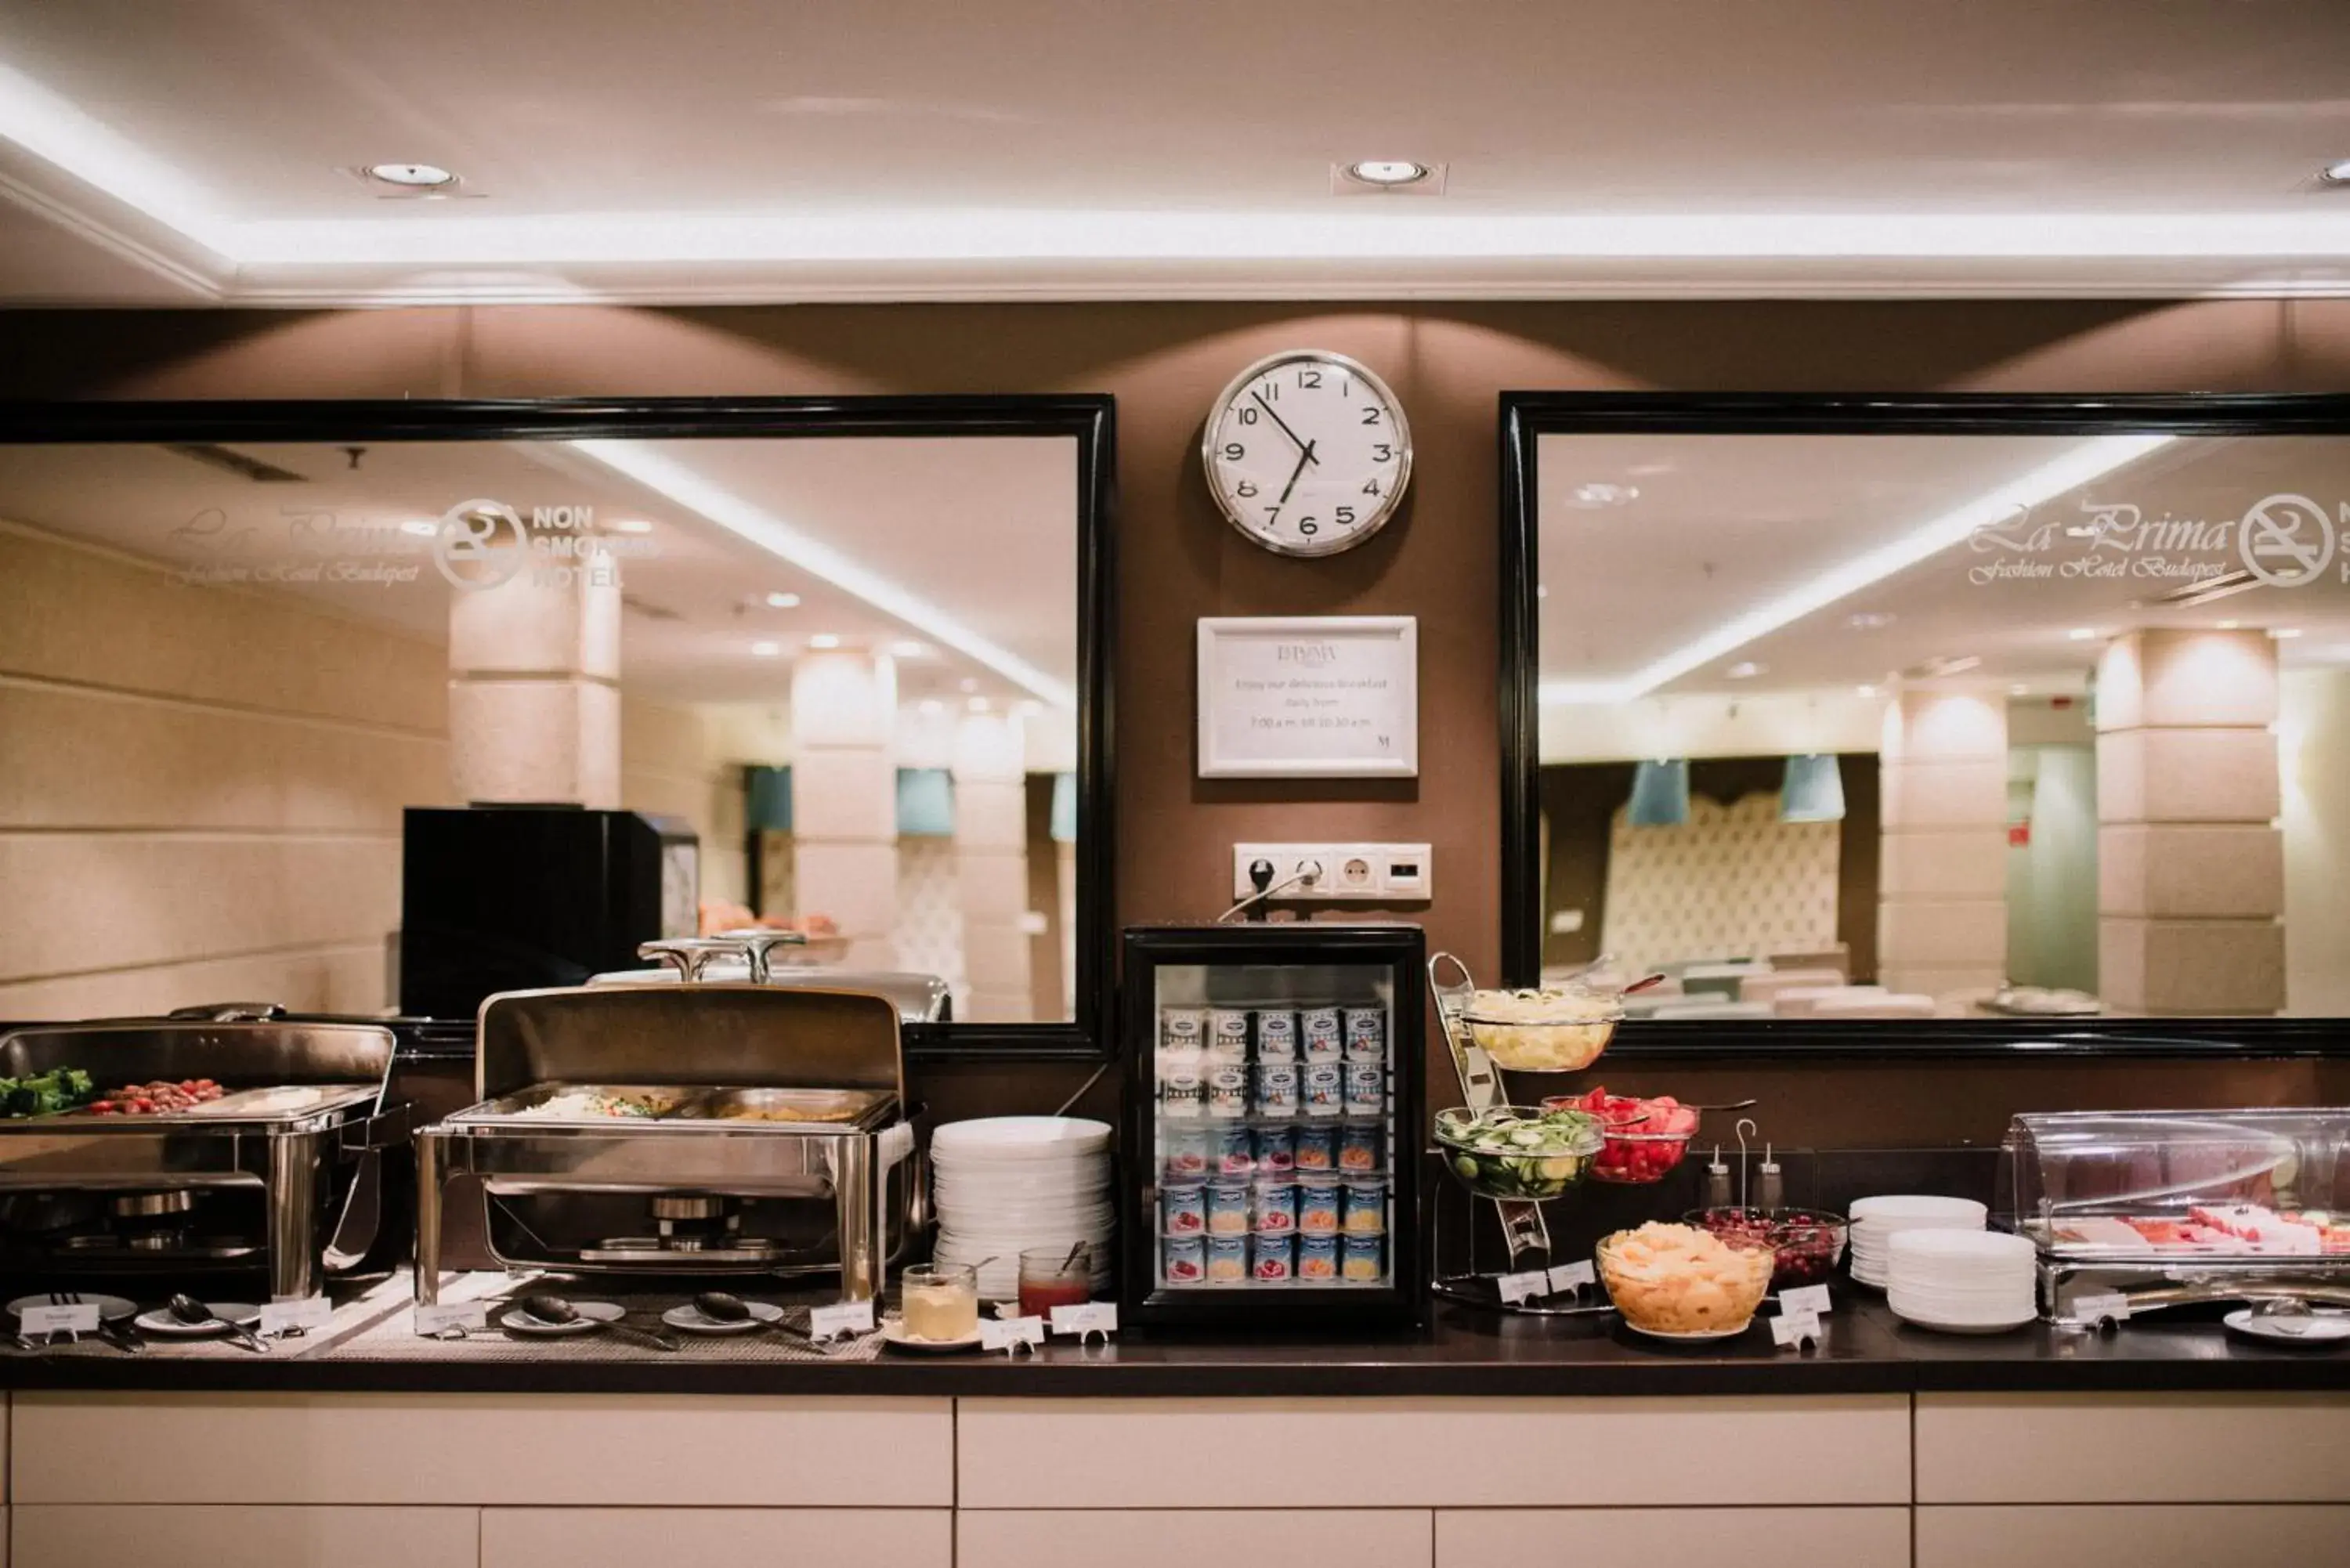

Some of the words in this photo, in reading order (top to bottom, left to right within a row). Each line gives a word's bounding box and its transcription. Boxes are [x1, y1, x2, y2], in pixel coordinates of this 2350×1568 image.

[1298, 371, 1321, 388] 12
[1265, 383, 1278, 401] 11
[1343, 381, 1348, 398] 1
[1238, 408, 1257, 425] 10
[1361, 406, 1380, 425] 2
[1225, 443, 1244, 461] 9
[1372, 444, 1391, 462] 3
[1237, 480, 1259, 497] 8
[1361, 478, 1380, 496] 4
[533, 506, 593, 529] NON
[1264, 507, 1281, 526] 7
[1336, 506, 1354, 524] 5
[1299, 516, 1318, 535] 6
[1968, 503, 2062, 553] La
[2080, 498, 2236, 552] Prima
[1968, 556, 2054, 585] Fashion
[2060, 555, 2129, 579] Hotel
[2132, 556, 2227, 583] Budapest
